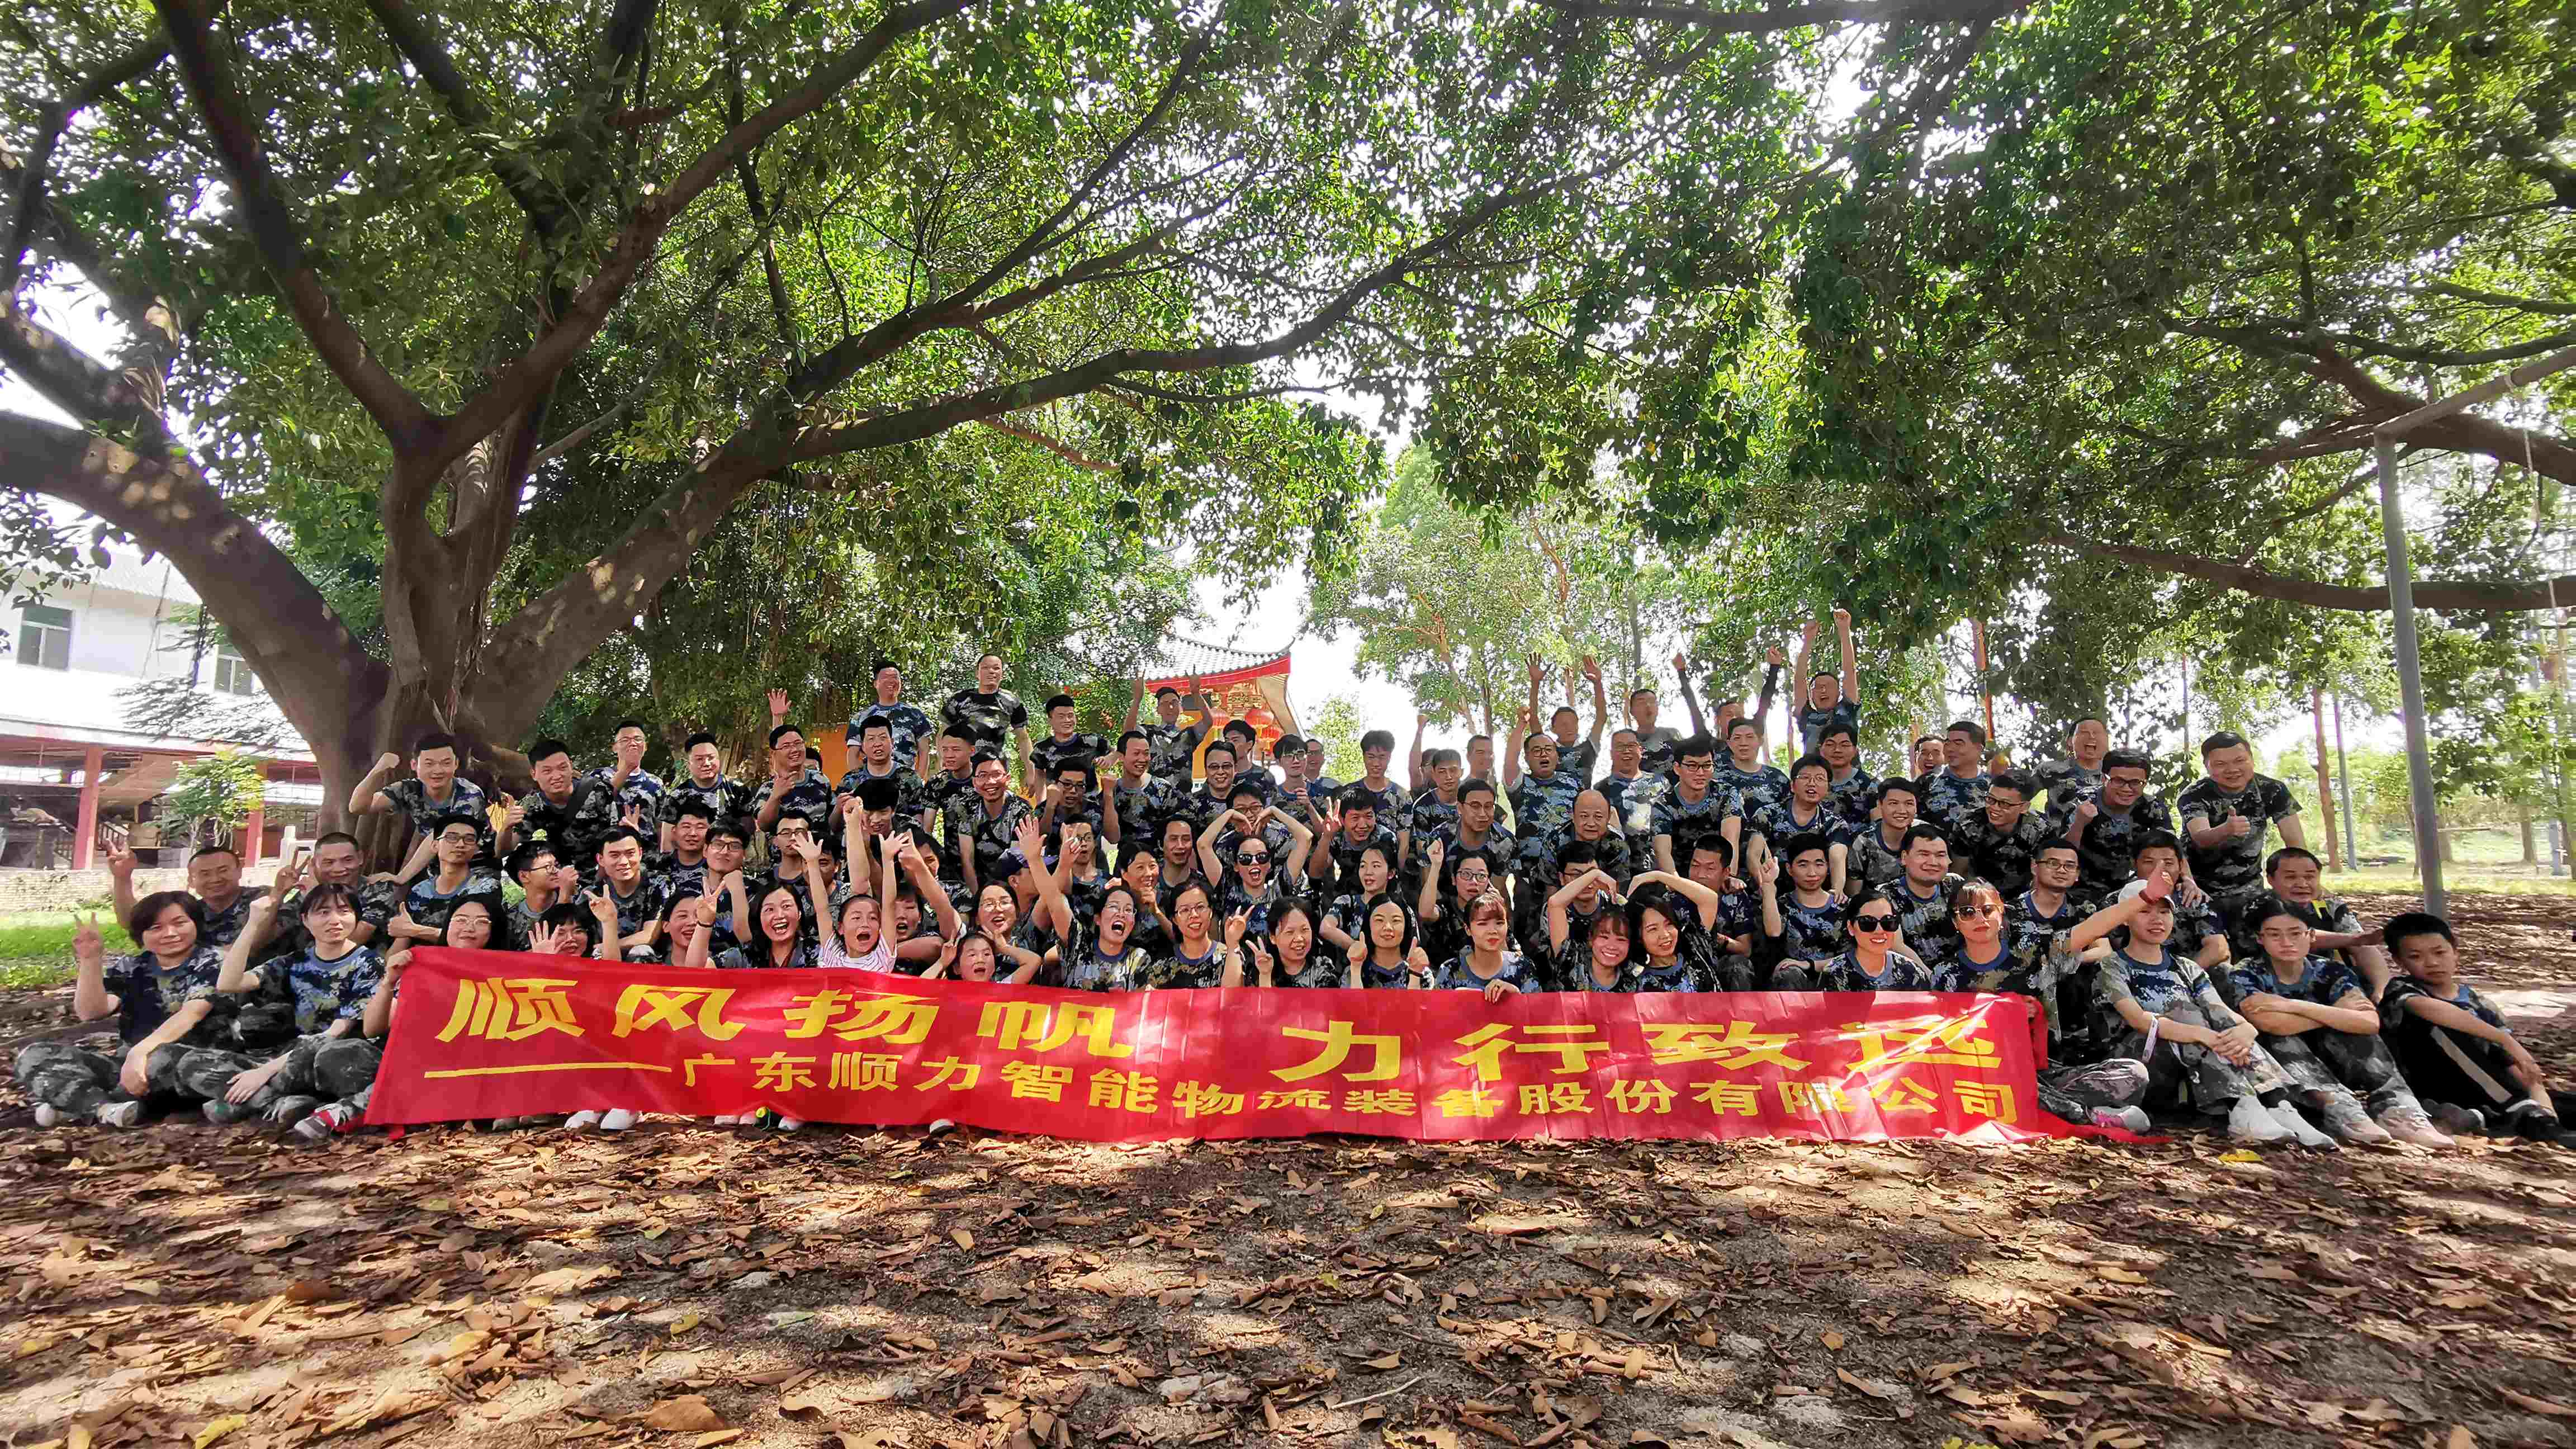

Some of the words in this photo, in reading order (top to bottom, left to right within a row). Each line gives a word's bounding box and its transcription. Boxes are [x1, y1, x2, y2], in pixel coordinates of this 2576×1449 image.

[436, 978, 1136, 1058] 顺风扬帆
[1270, 1019, 2002, 1083] 力行致远
